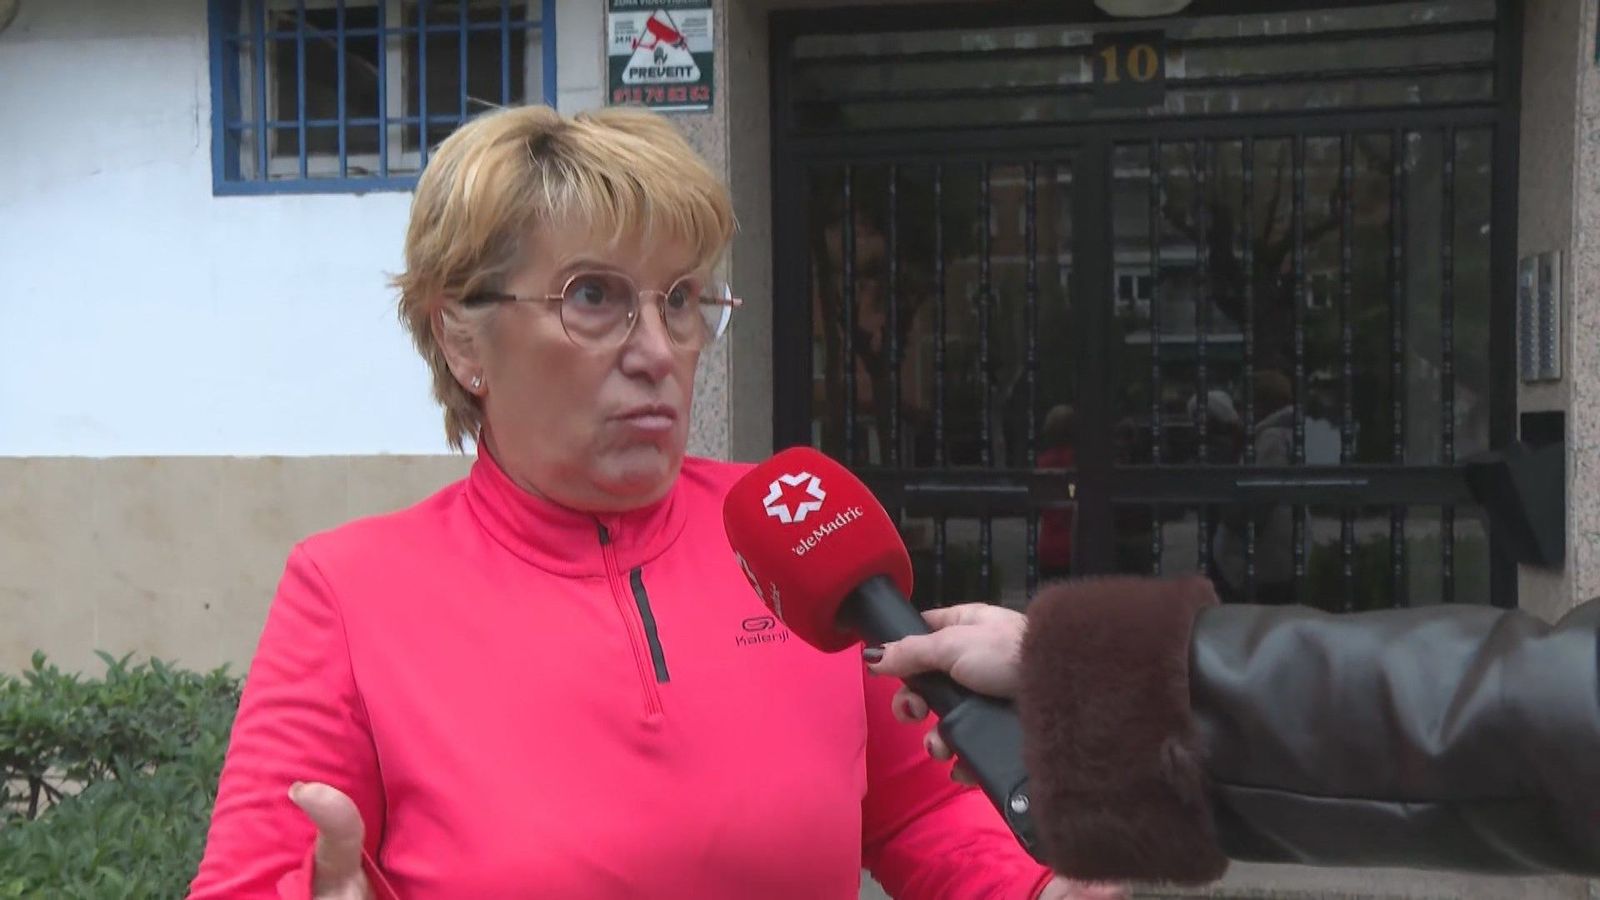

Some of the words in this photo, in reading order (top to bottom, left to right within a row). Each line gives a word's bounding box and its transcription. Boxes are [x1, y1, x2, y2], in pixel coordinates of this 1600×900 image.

[629, 65, 694, 79] PREVENT
[1101, 44, 1159, 82] 10
[792, 506, 864, 556] eleMadri
